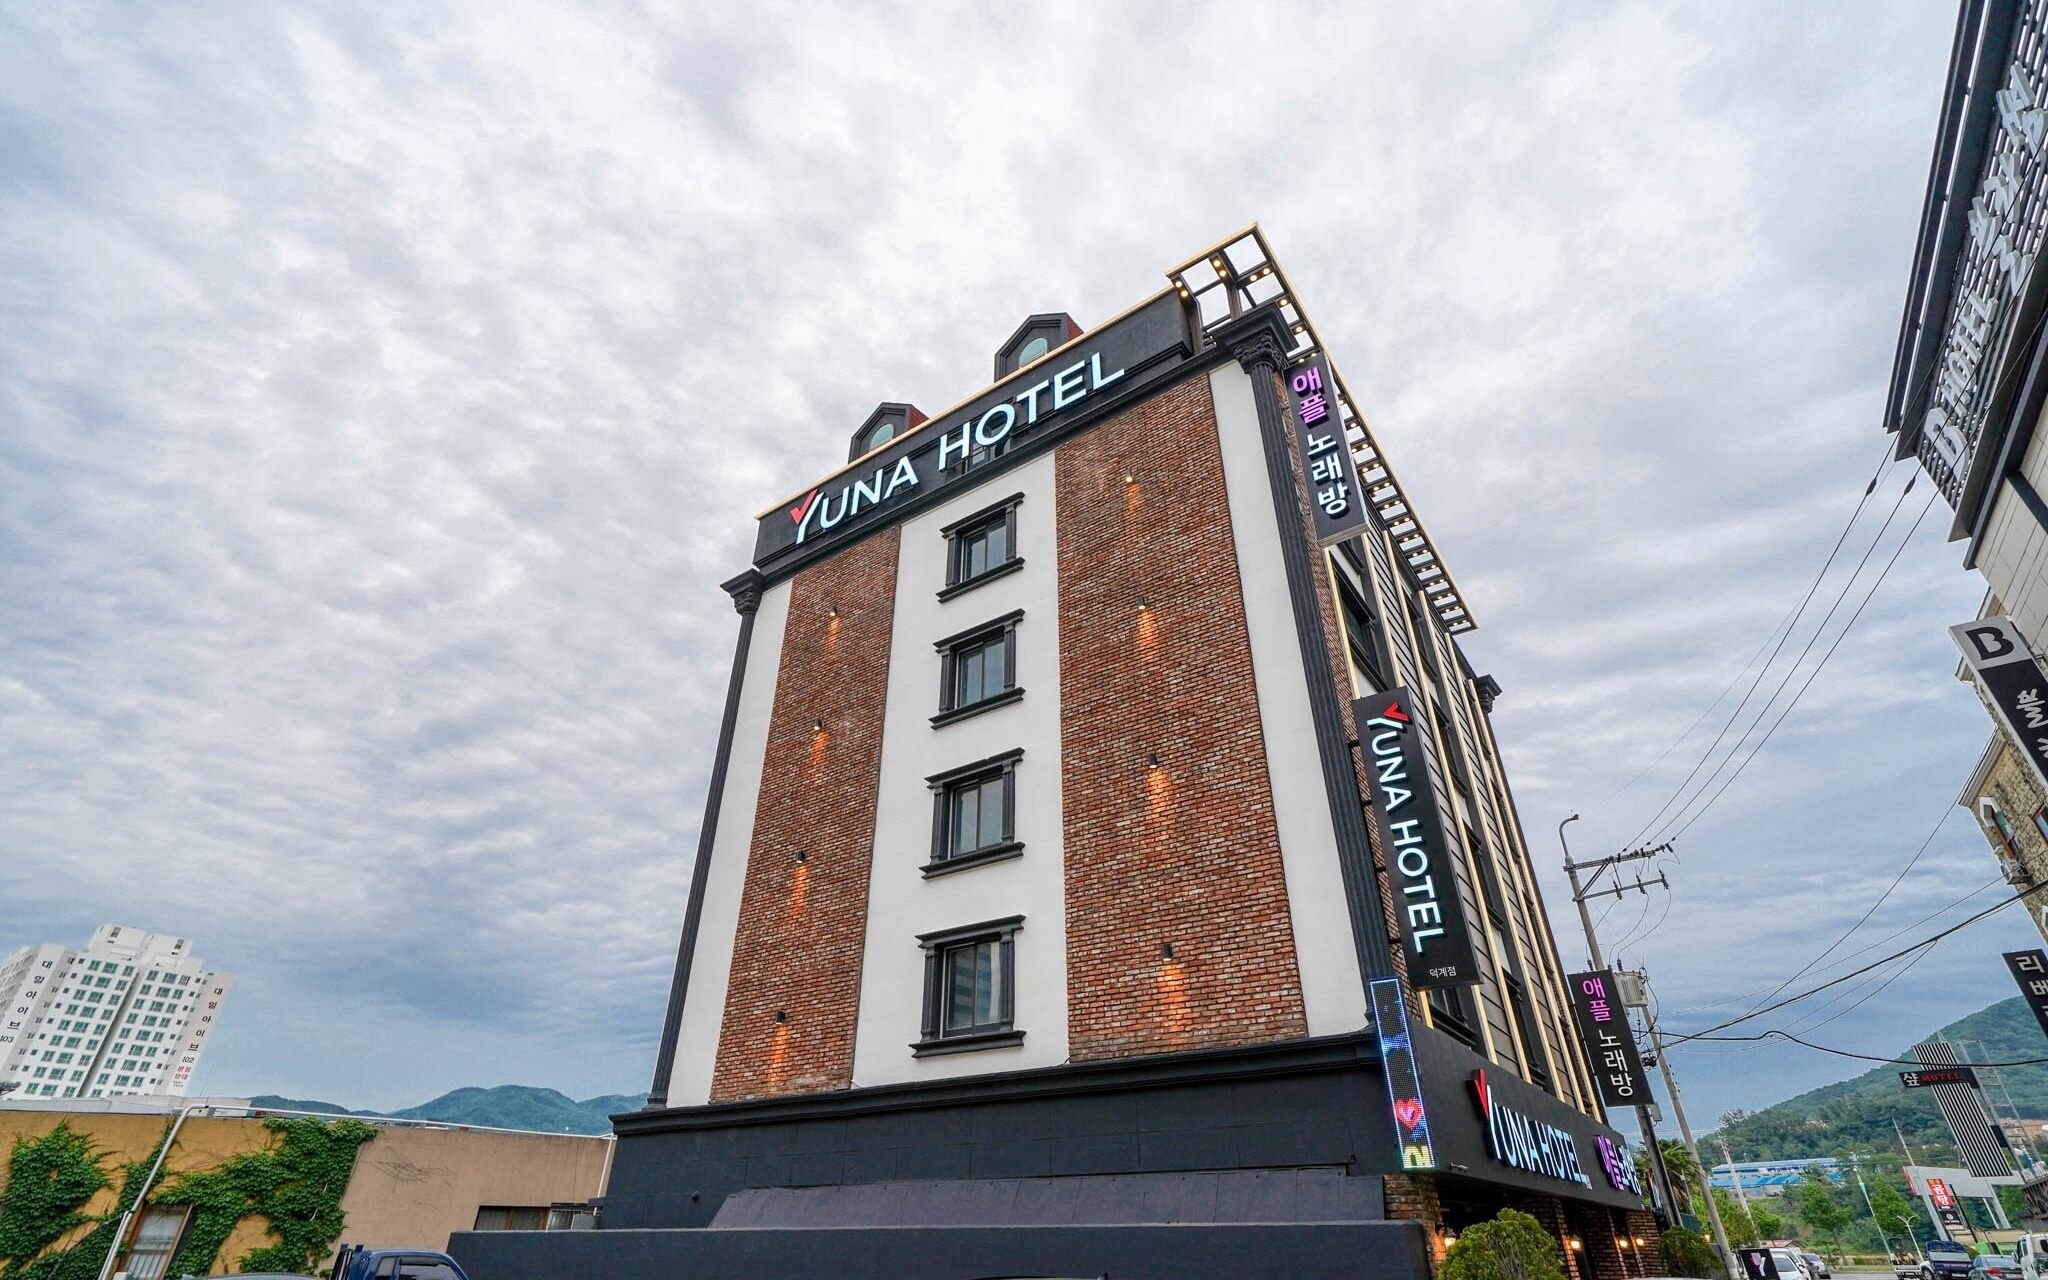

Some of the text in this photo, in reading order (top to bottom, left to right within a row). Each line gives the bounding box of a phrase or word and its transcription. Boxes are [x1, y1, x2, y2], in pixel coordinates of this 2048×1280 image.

[1941, 287, 1998, 418] HOTEL
[790, 352, 1125, 545] YUNA HOTEL
[1293, 367, 1348, 516] 애플 노래방
[1965, 626, 2015, 661] B
[1366, 702, 1445, 954] YUNA HOTEL
[1429, 966, 1457, 979] 덕계점
[182, 1056, 195, 1064] 102
[1582, 977, 1634, 1097] 애플 노래방
[1474, 1067, 1588, 1185] YUNA HOTEL
